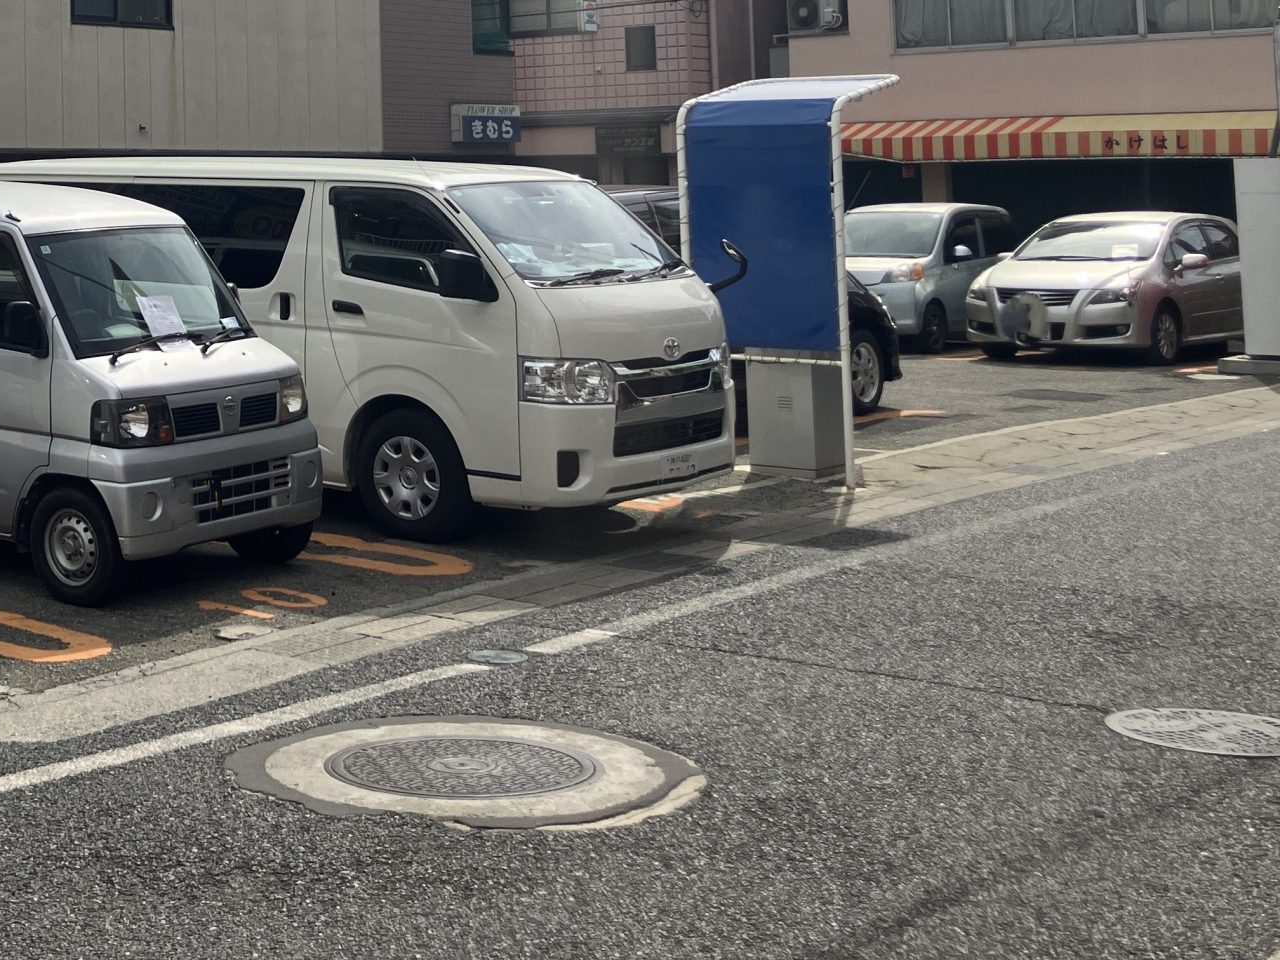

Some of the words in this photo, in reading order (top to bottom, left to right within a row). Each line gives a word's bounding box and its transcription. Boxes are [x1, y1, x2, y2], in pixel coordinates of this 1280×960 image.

[466, 105, 496, 115] FLOWER
[498, 106, 516, 116] SHOP
[472, 119, 513, 139] きむら
[1104, 135, 1188, 150] かけはし
